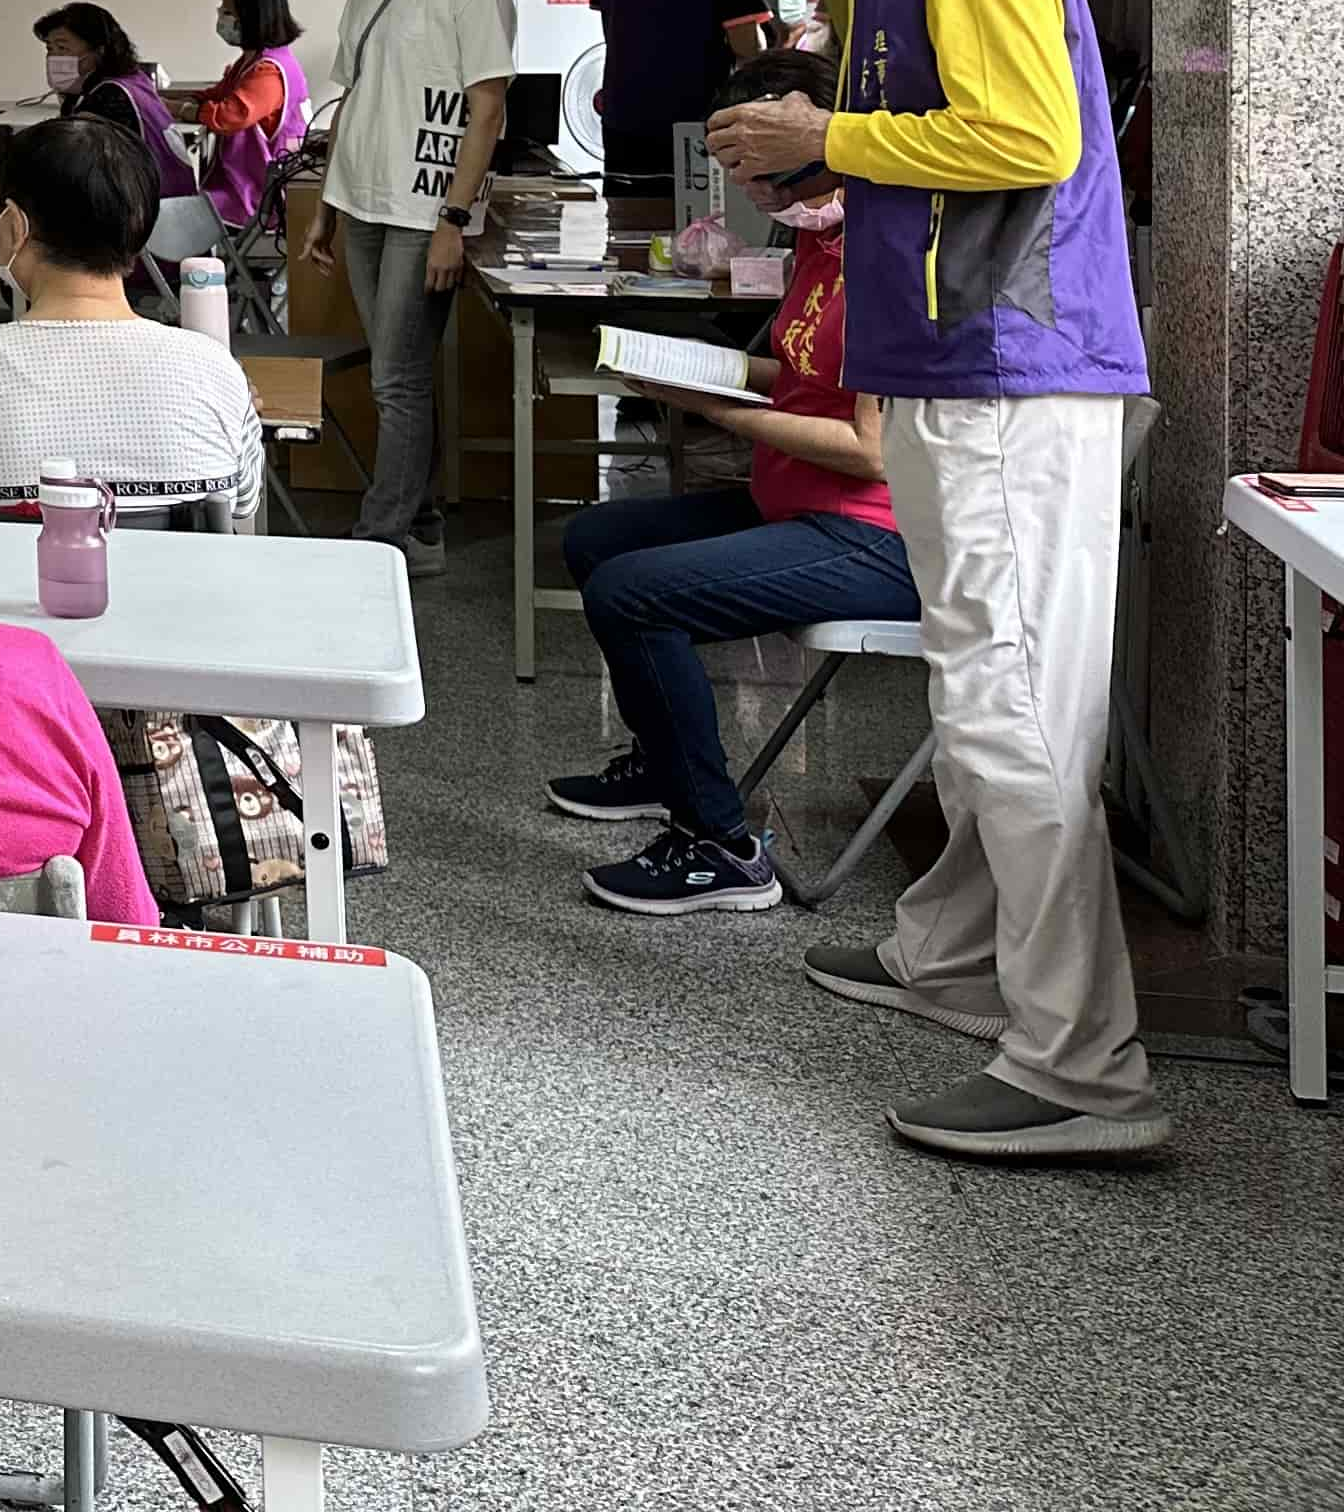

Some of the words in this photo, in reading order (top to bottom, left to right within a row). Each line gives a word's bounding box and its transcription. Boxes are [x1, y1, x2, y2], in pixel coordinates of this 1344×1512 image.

[418, 138, 463, 164] AR
[116, 482, 160, 496] ROSE
[163, 481, 204, 495] ROSE
[115, 928, 285, 956] 員林市公所
[296, 945, 365, 962] 補助
